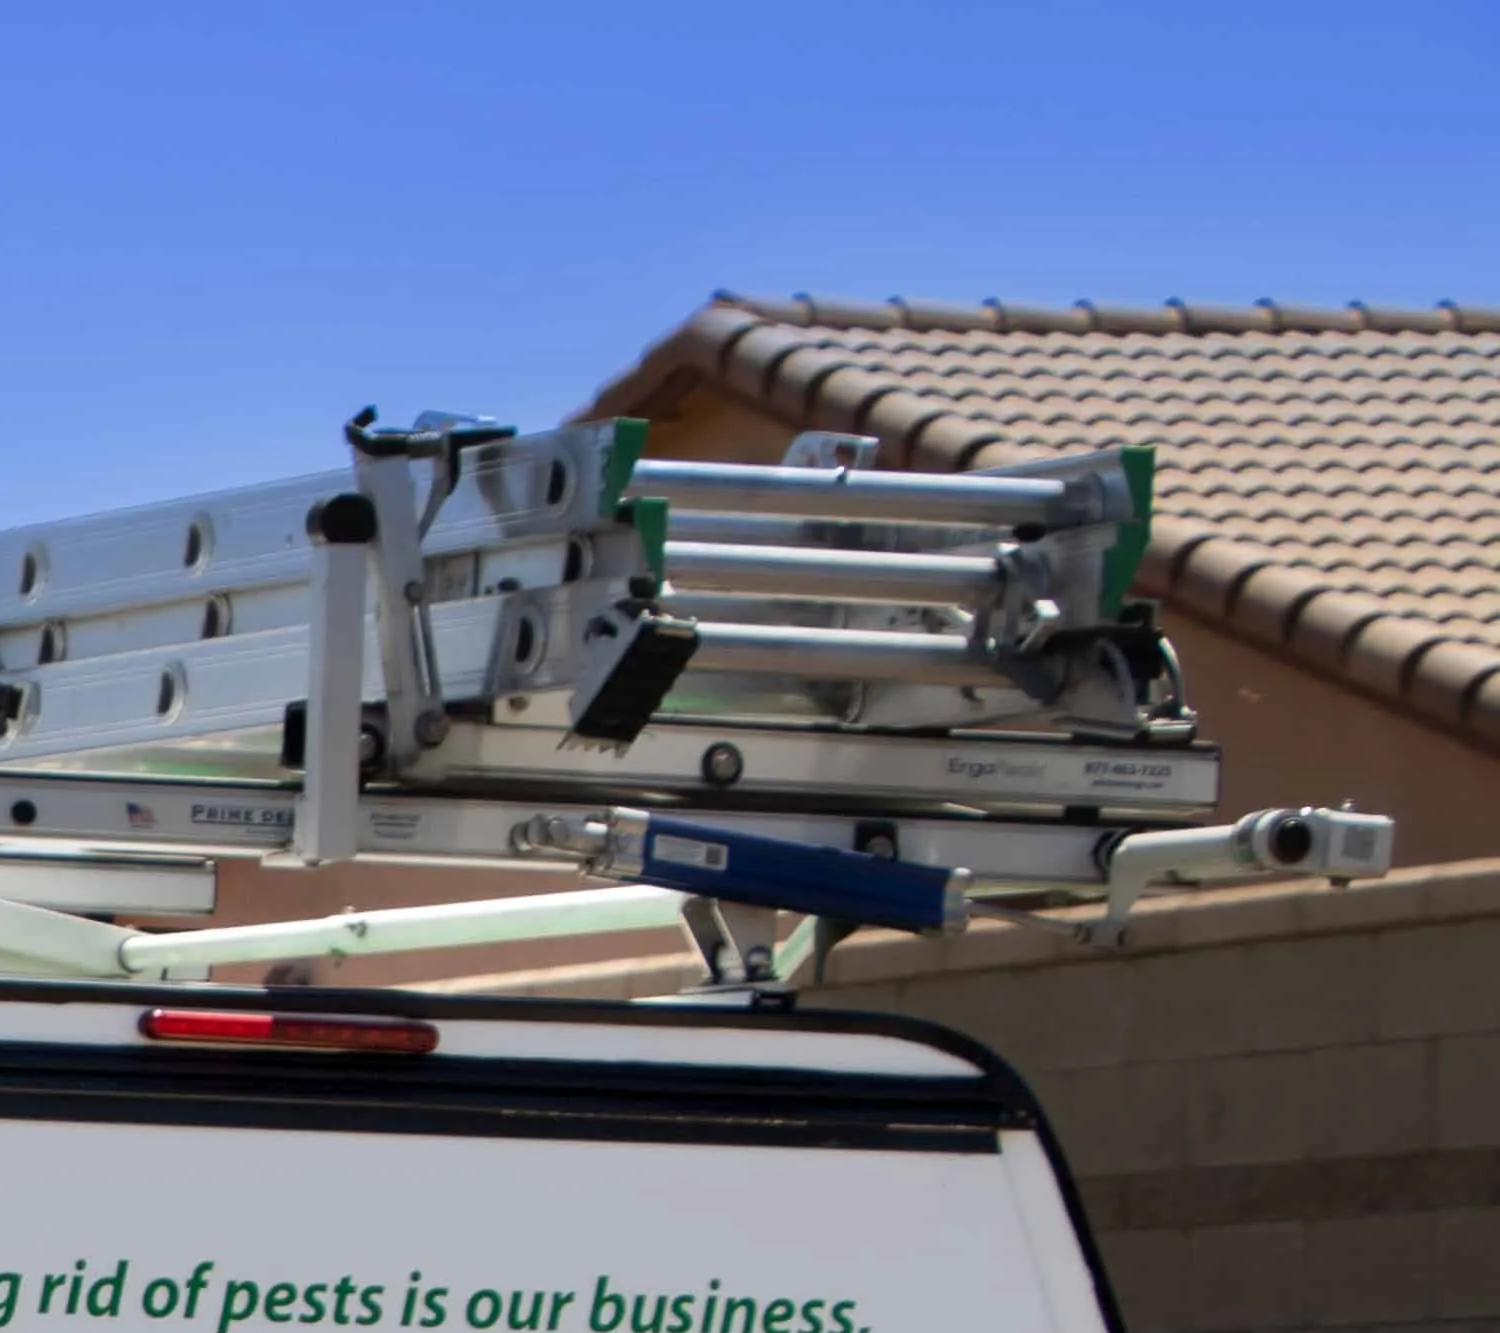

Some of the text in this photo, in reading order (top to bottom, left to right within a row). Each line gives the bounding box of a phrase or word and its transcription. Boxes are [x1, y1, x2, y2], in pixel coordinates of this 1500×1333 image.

[190, 803, 254, 822] PRIME
[38, 1259, 128, 1317] rid
[141, 1261, 213, 1320] of
[400, 1271, 448, 1328] is
[465, 1285, 574, 1333] our
